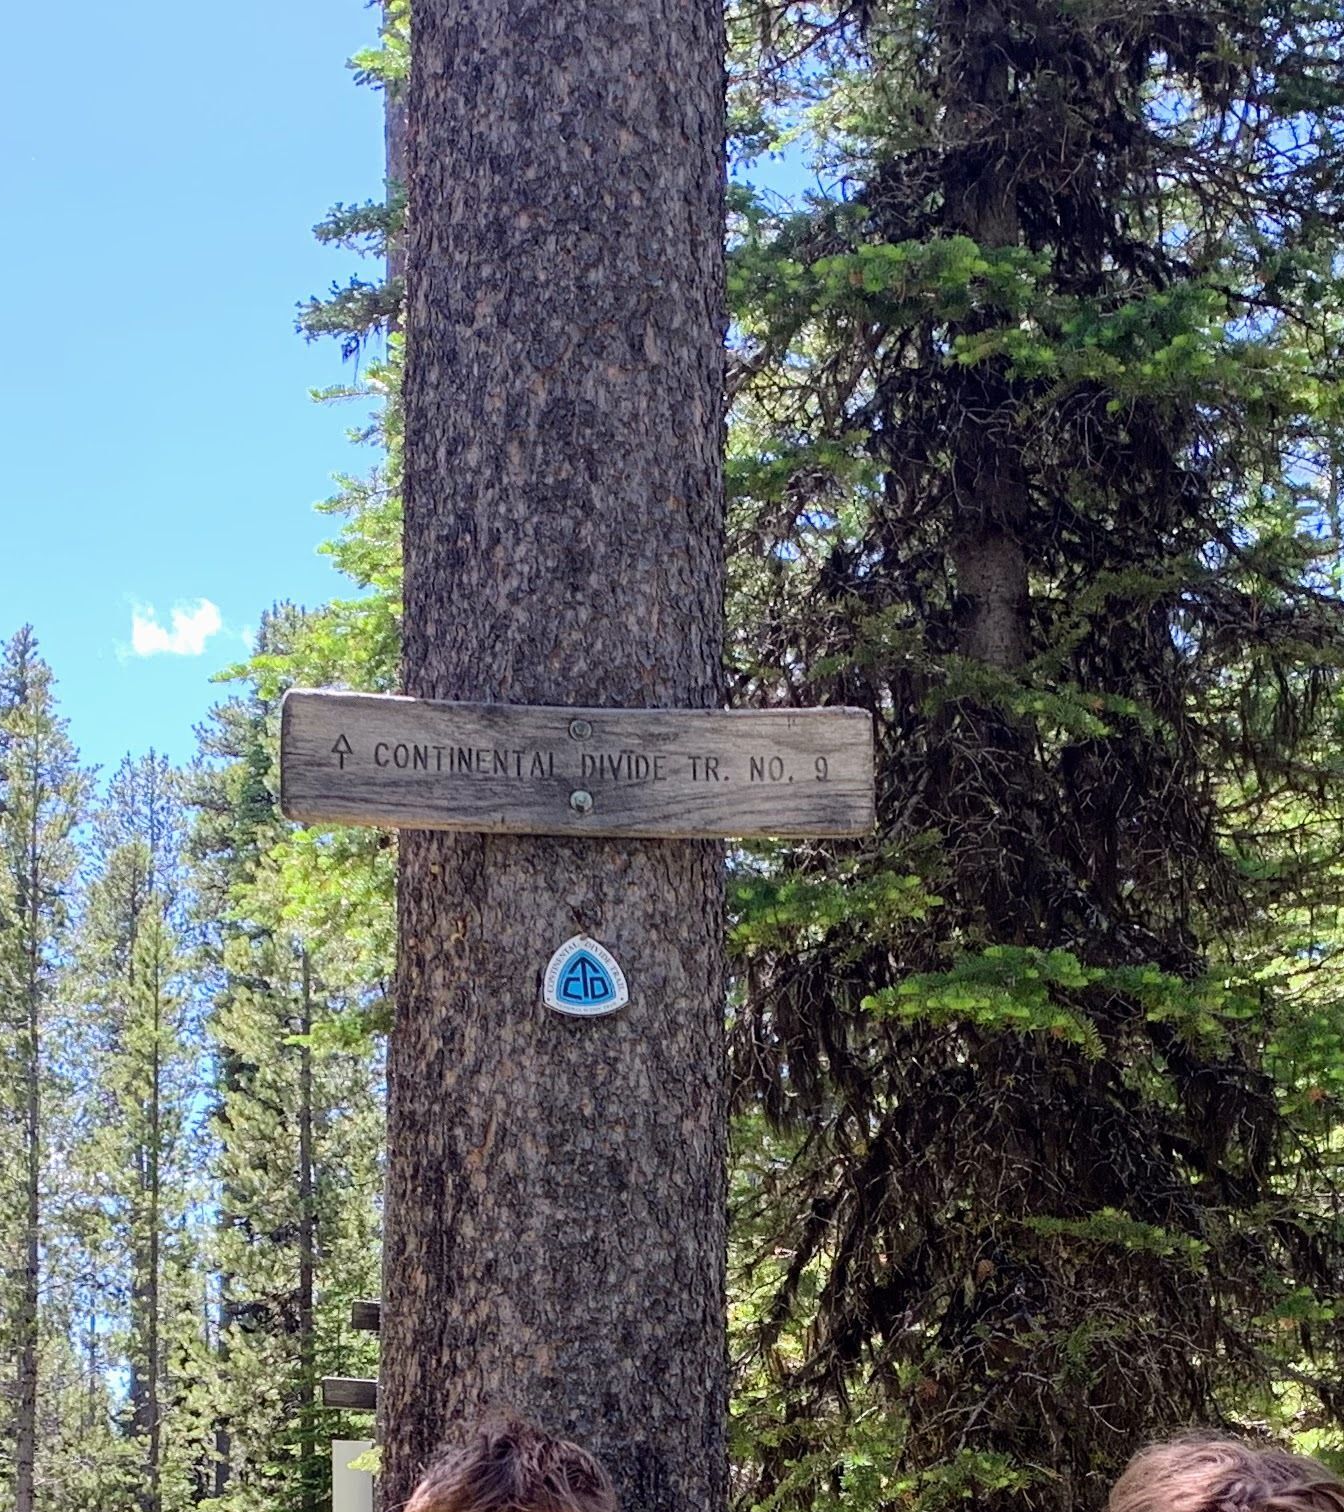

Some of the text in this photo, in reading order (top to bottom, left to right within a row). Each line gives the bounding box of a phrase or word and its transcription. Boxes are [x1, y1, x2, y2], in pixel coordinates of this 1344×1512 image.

[374, 741, 830, 783] CONTINENTAL DIVIDE TR. NO. 9
